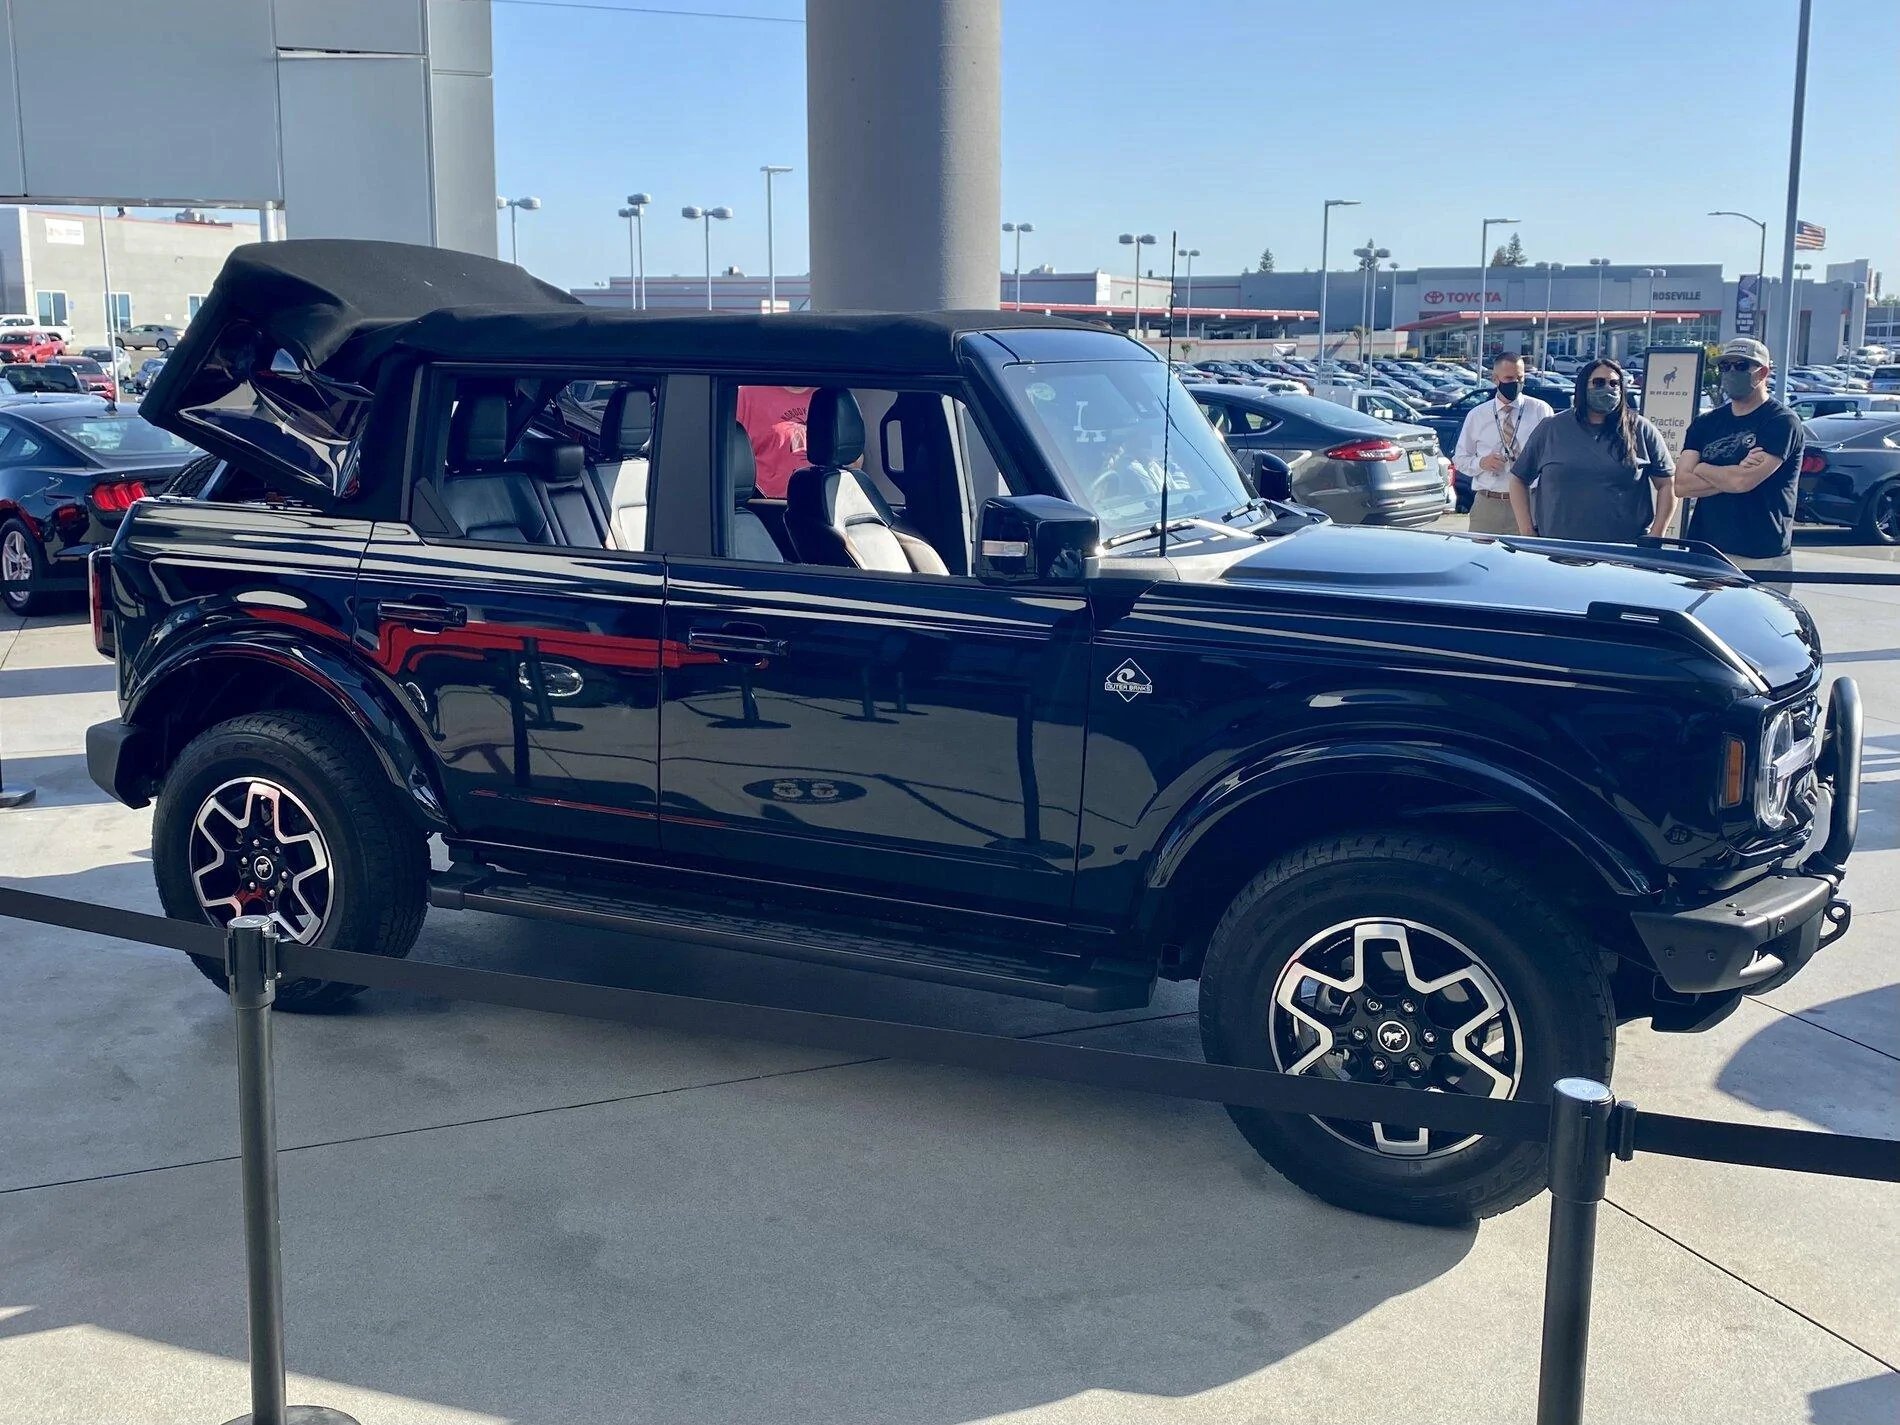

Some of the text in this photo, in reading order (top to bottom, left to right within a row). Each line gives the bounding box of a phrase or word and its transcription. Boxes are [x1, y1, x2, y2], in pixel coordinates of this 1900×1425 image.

[1446, 292, 1502, 303] TOYOTA
[1652, 291, 1700, 300] ROSEVILLE
[1106, 683, 1152, 693] OUTER BANKS
